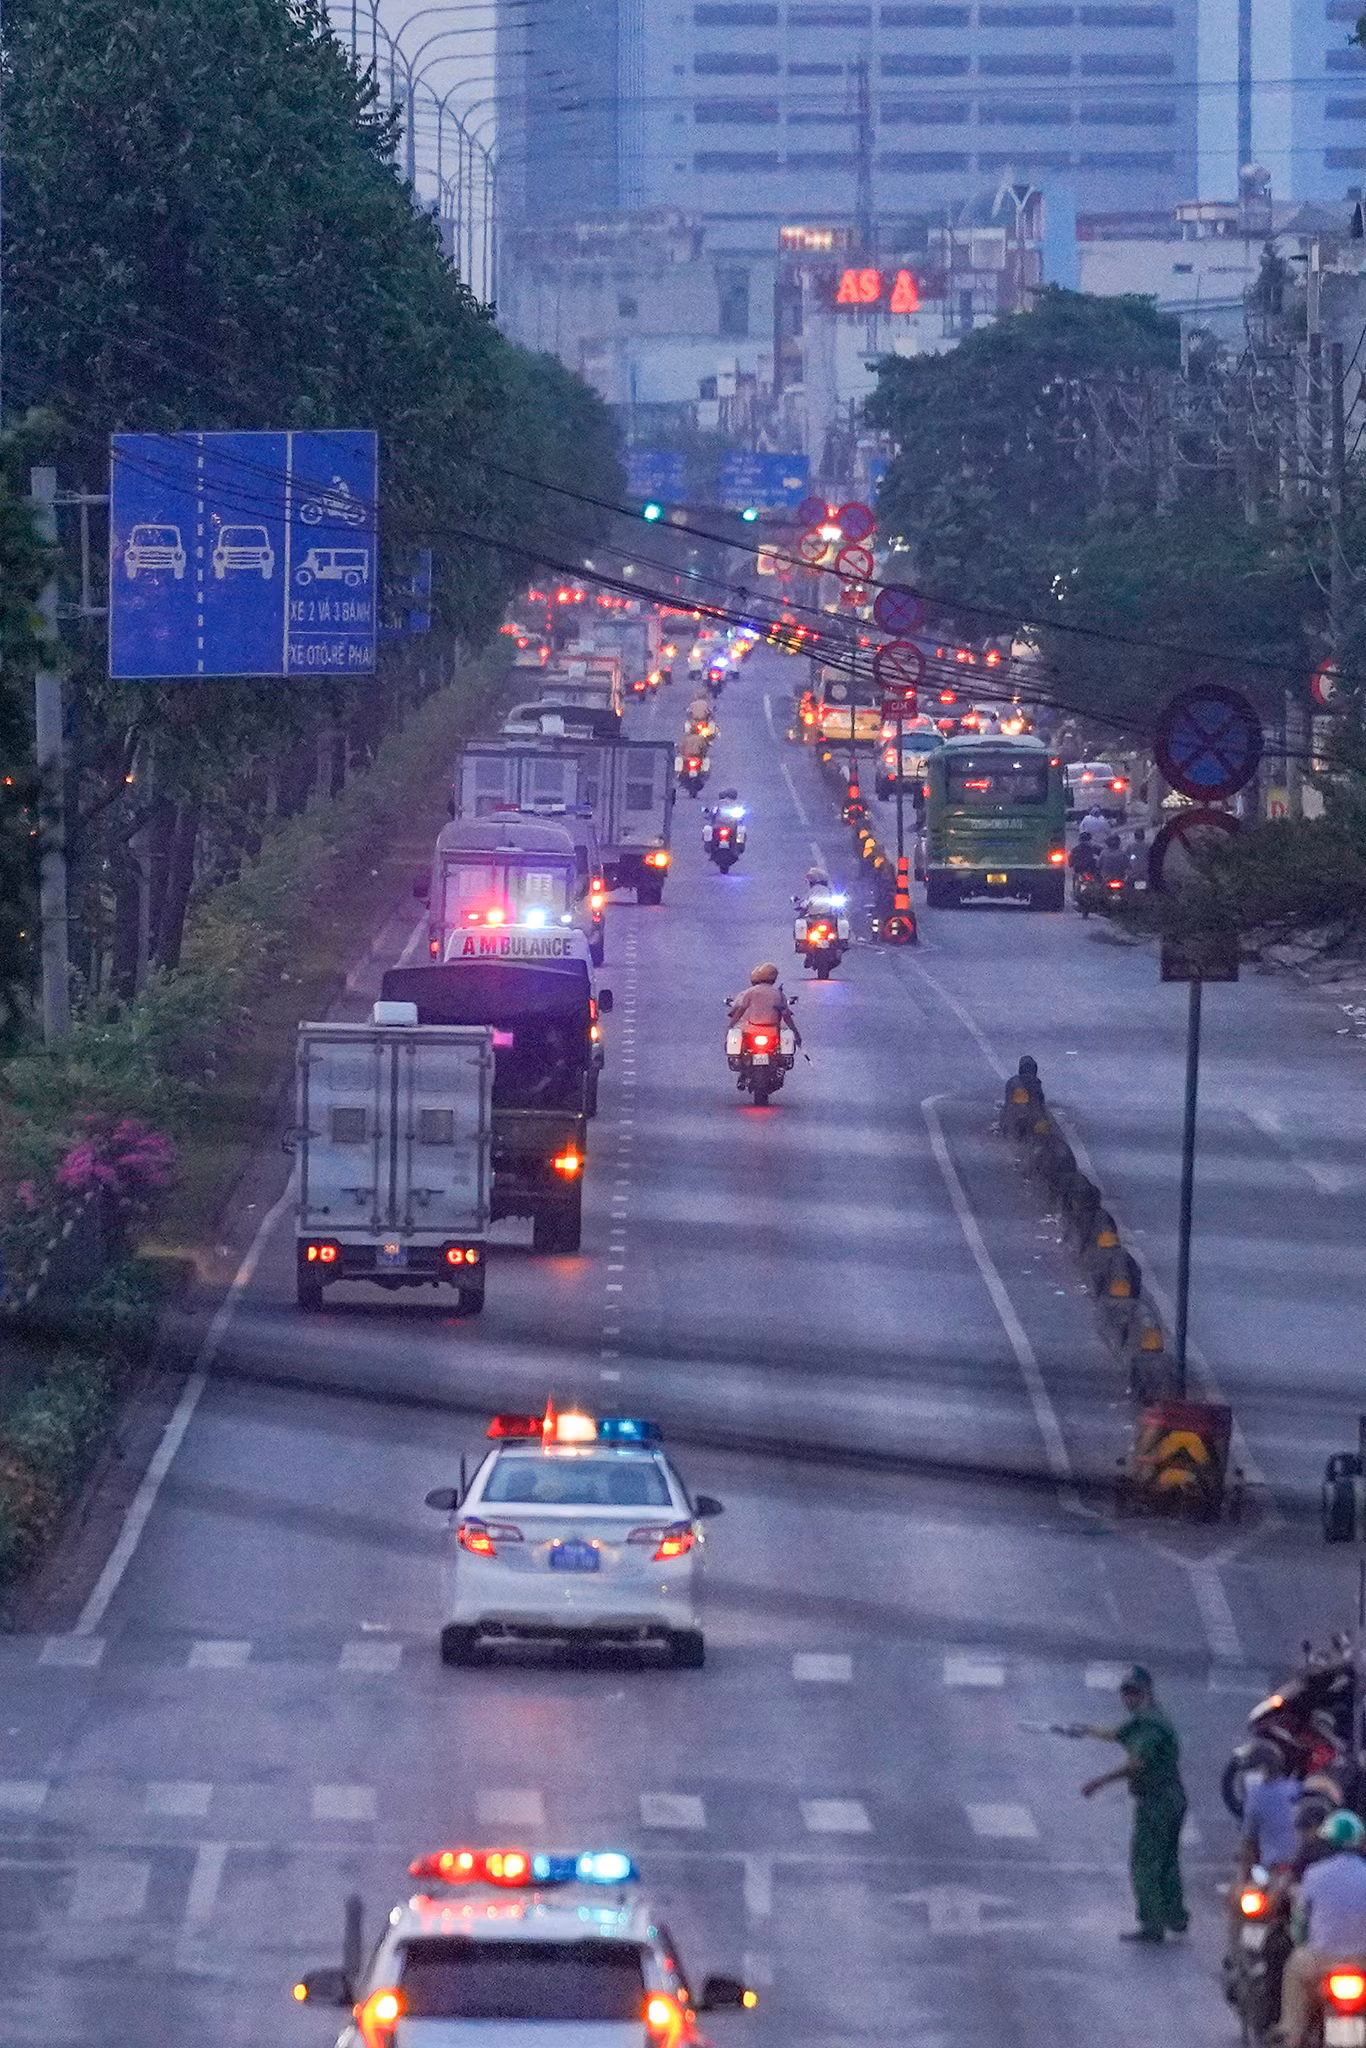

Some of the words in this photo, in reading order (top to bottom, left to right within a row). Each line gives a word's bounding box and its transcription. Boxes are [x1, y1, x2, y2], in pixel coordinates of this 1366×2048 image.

[290, 600, 305, 622] XE
[308, 600, 315, 622] 2
[289, 644, 304, 666] XE
[462, 935, 573, 957] AMBULANCE
